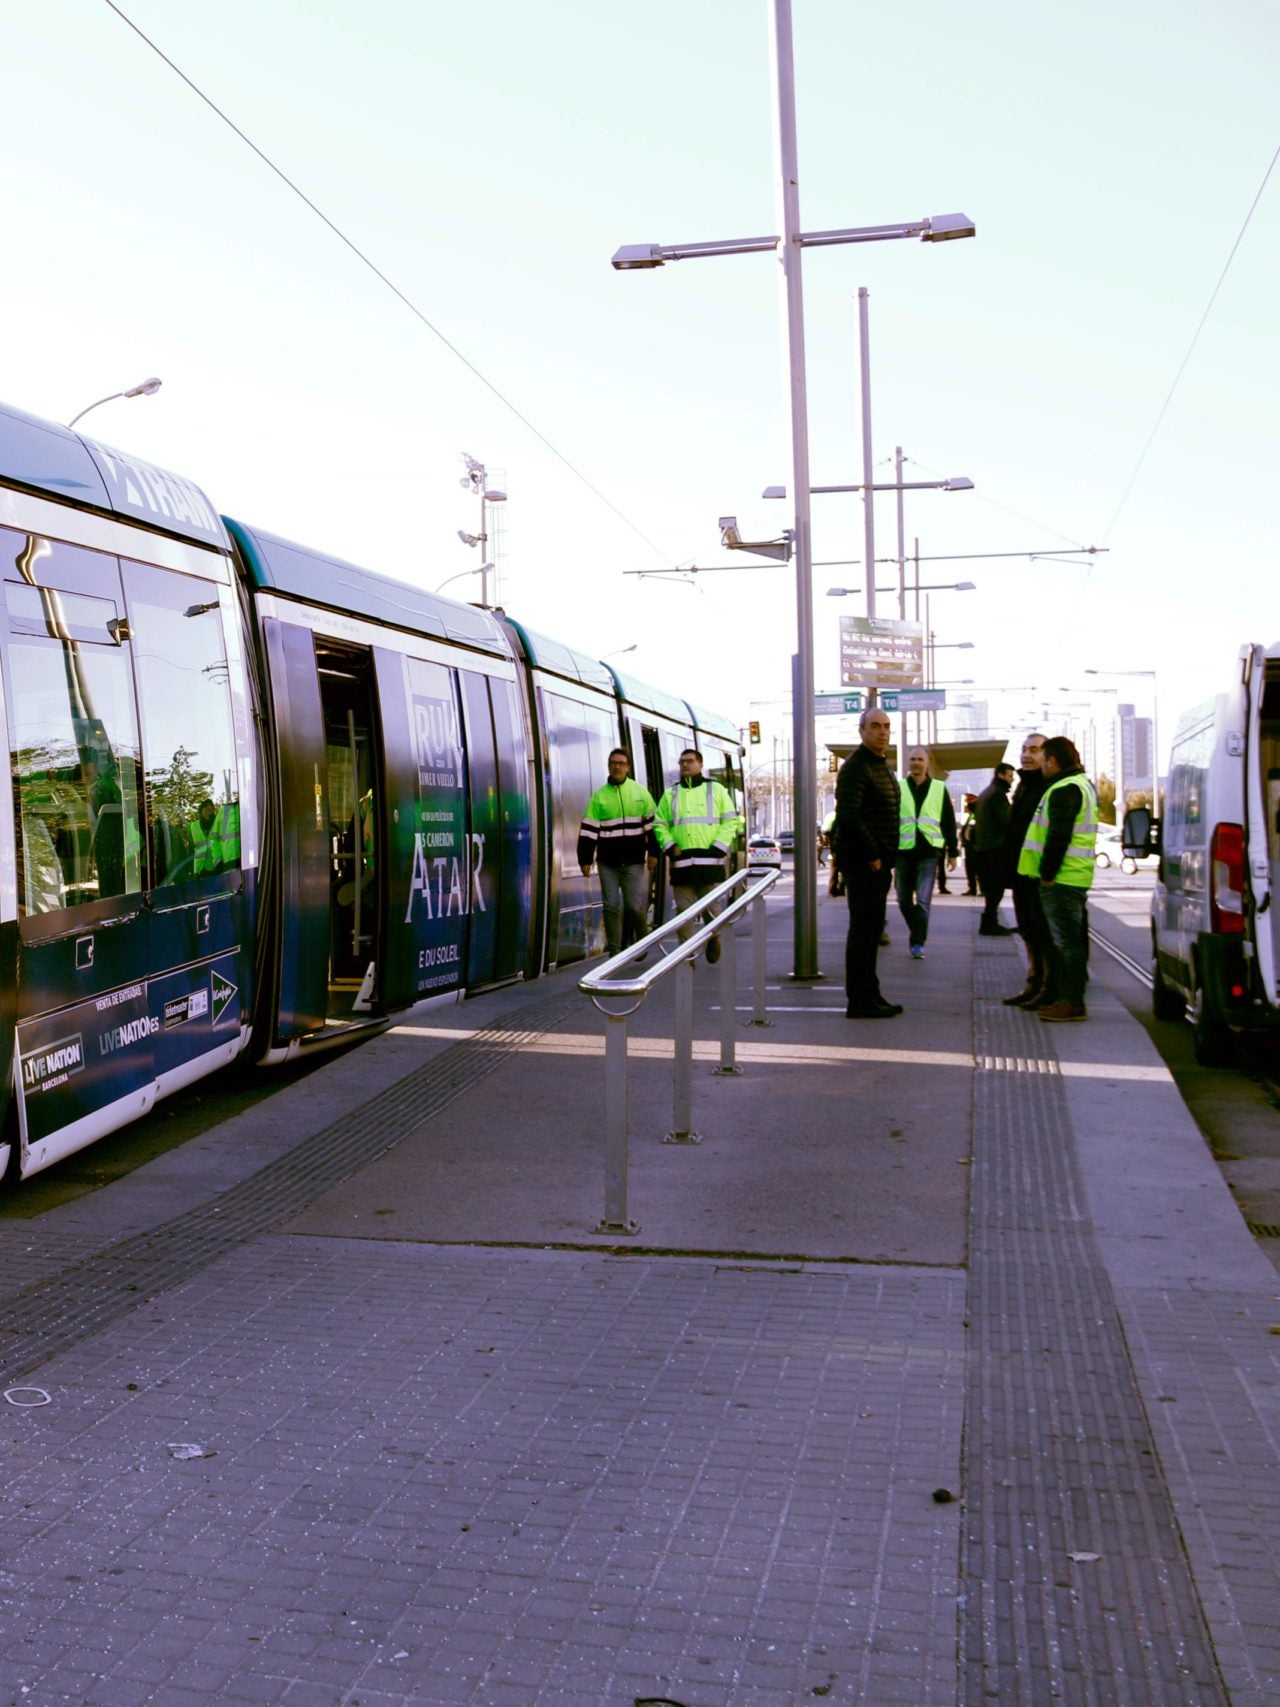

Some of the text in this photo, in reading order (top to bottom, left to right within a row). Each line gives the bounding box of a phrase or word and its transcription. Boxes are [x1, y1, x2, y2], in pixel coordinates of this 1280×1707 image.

[436, 773, 455, 788] VUELO
[426, 831, 455, 849] CAMERON
[425, 948, 437, 967] DU
[95, 996, 113, 1012] VENTA
[111, 994, 120, 1006] DE
[45, 1043, 81, 1075] NATION
[41, 1072, 69, 1092] BARCELONA
